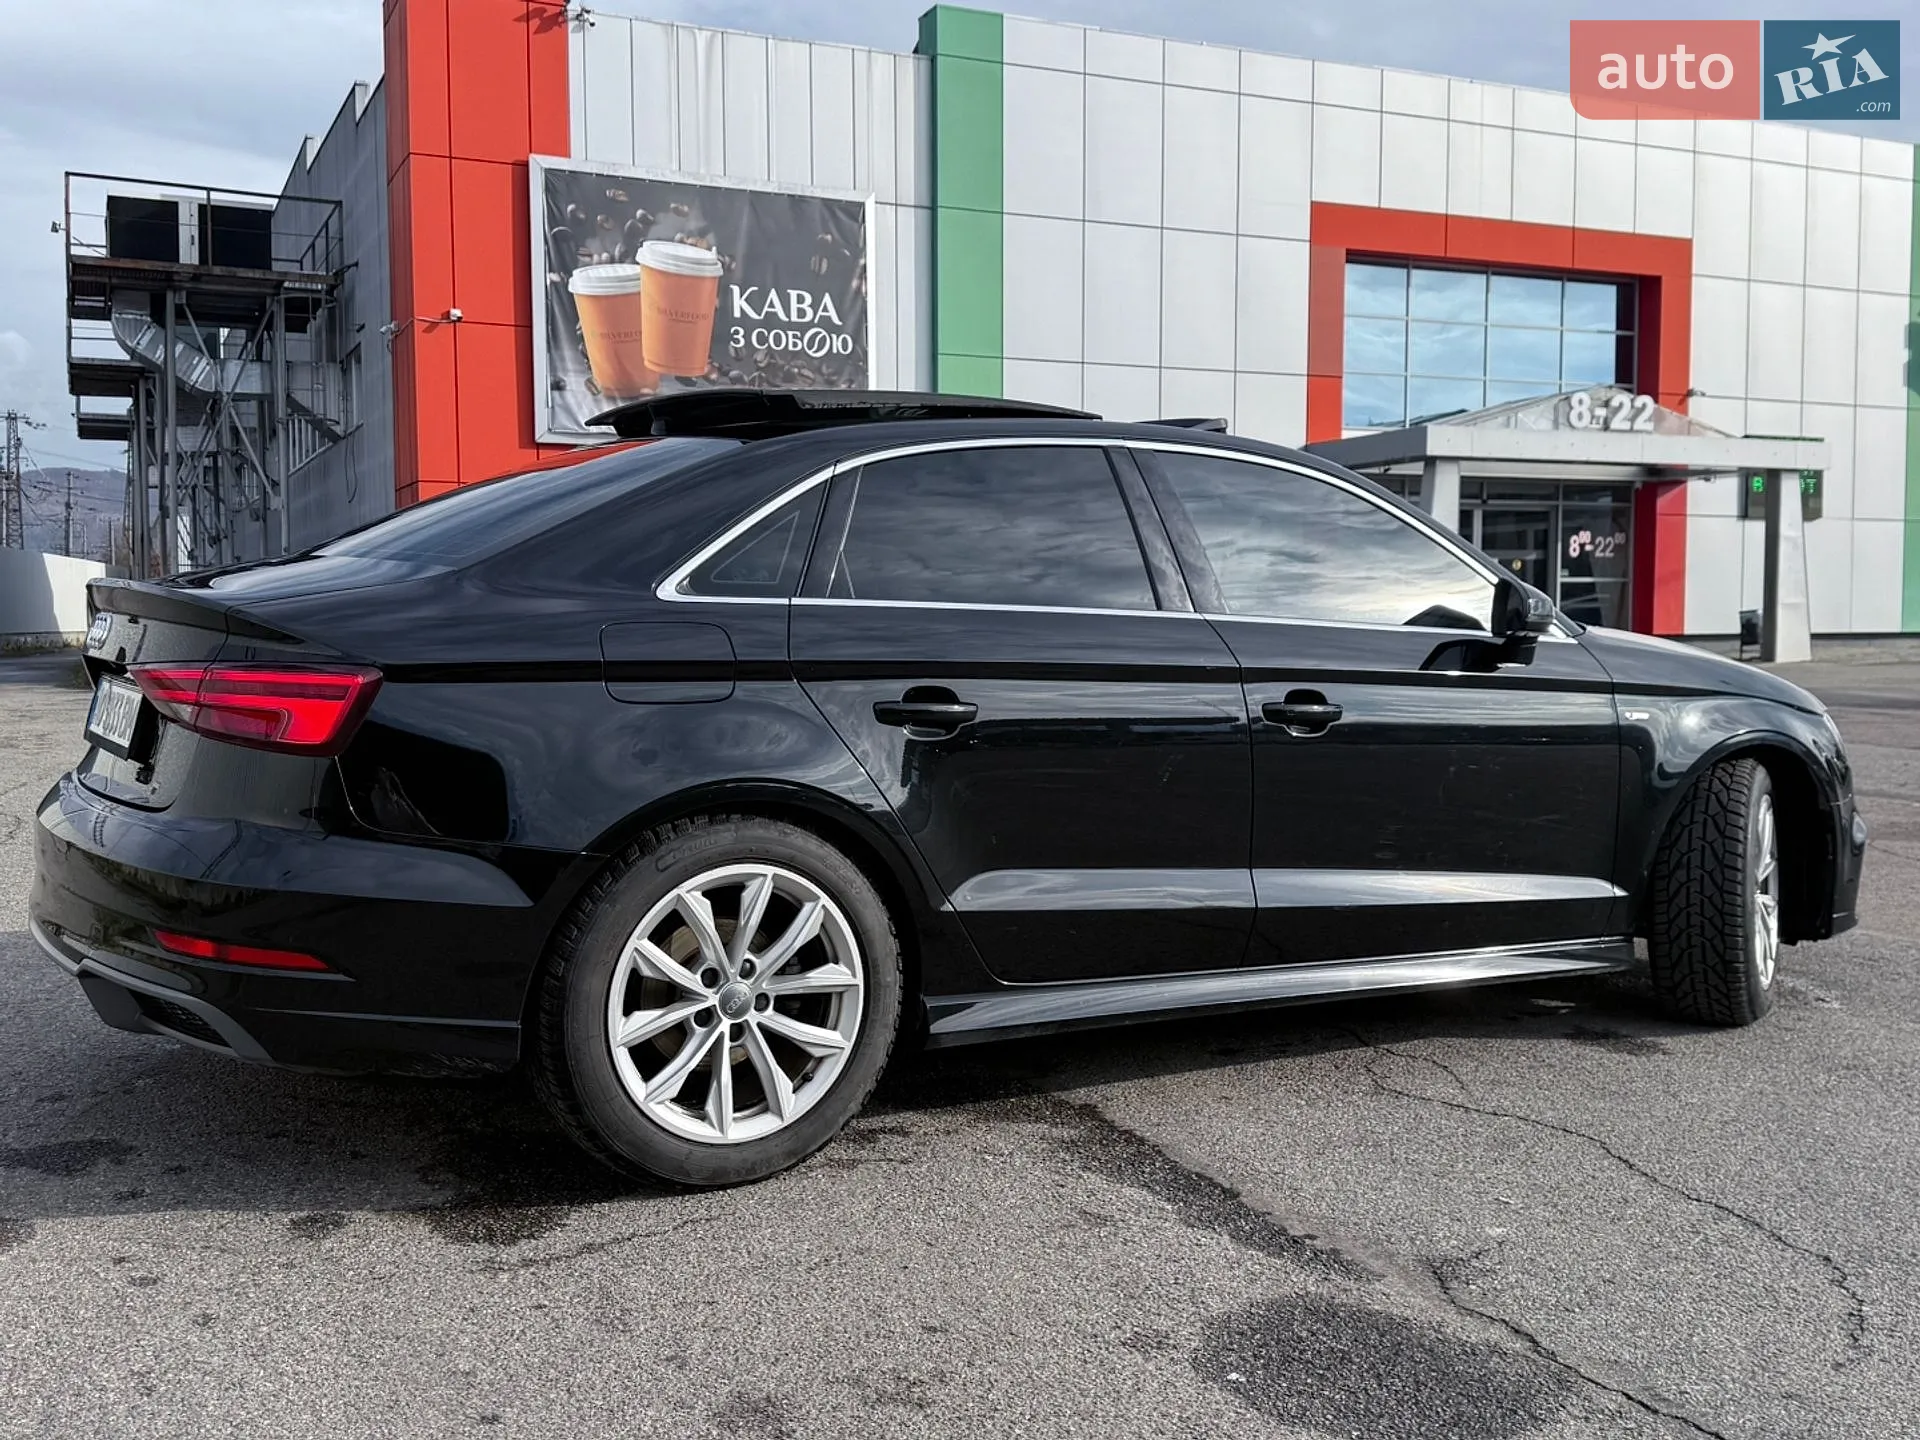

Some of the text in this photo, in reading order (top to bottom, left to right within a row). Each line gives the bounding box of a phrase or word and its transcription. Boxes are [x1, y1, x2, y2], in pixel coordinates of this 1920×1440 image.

[729, 284, 843, 325] КАВА
[730, 326, 853, 358] З СОБОЮ
[1569, 392, 1655, 431] 8-22
